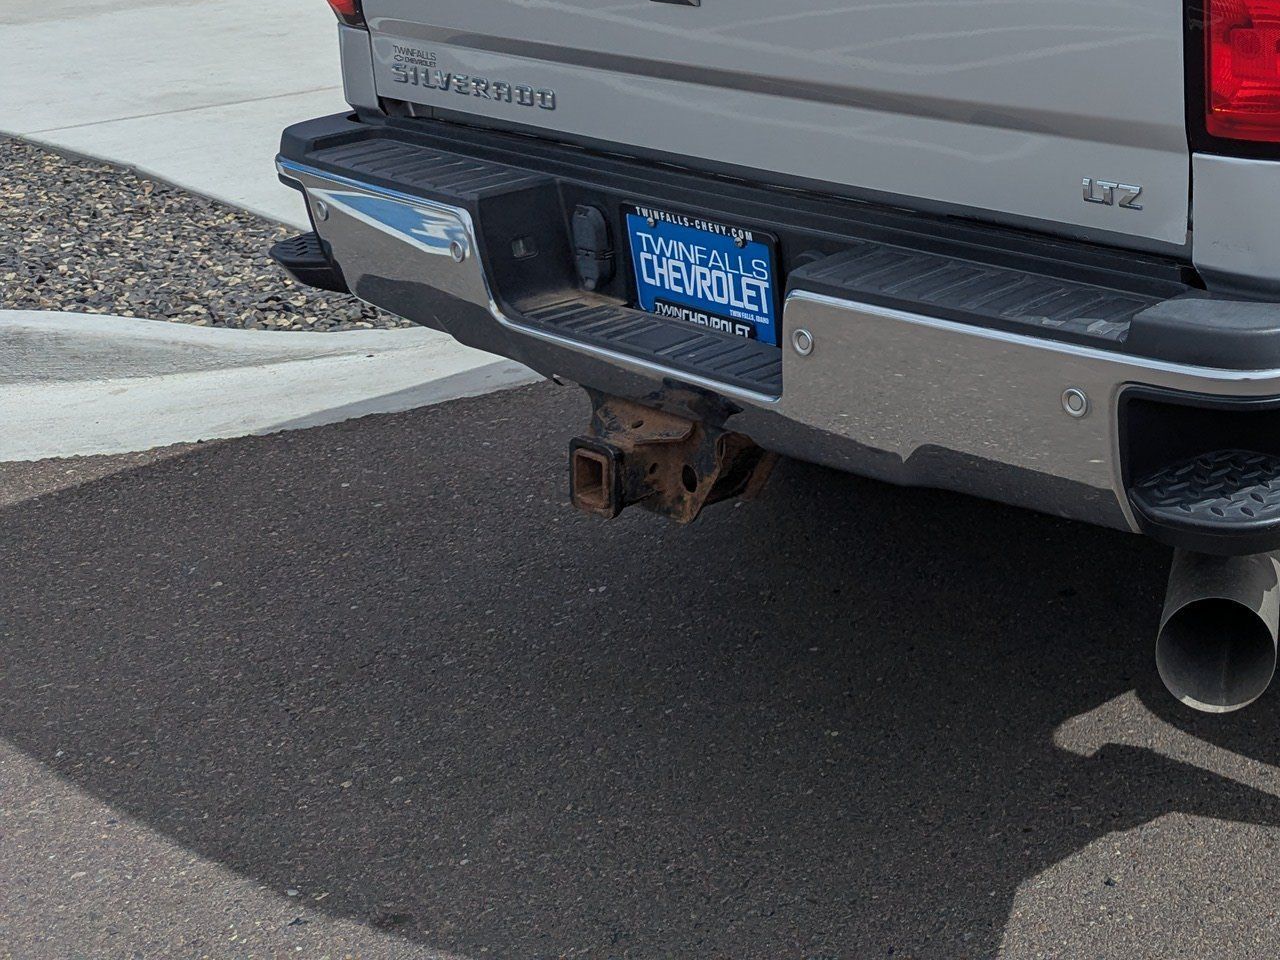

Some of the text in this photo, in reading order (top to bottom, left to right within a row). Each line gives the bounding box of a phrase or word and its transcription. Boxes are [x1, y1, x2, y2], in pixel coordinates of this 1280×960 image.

[392, 44, 437, 61] TWINFALLS
[404, 56, 437, 68] CHEVROLET
[391, 62, 556, 111] SILVERADO
[1082, 177, 1143, 210] LTZ
[635, 206, 753, 242] TWINFALLS-CHEVY.COM
[636, 231, 768, 281] TWINFALLS
[640, 251, 769, 314] CHEVROLET
[729, 309, 742, 318] TWIN
